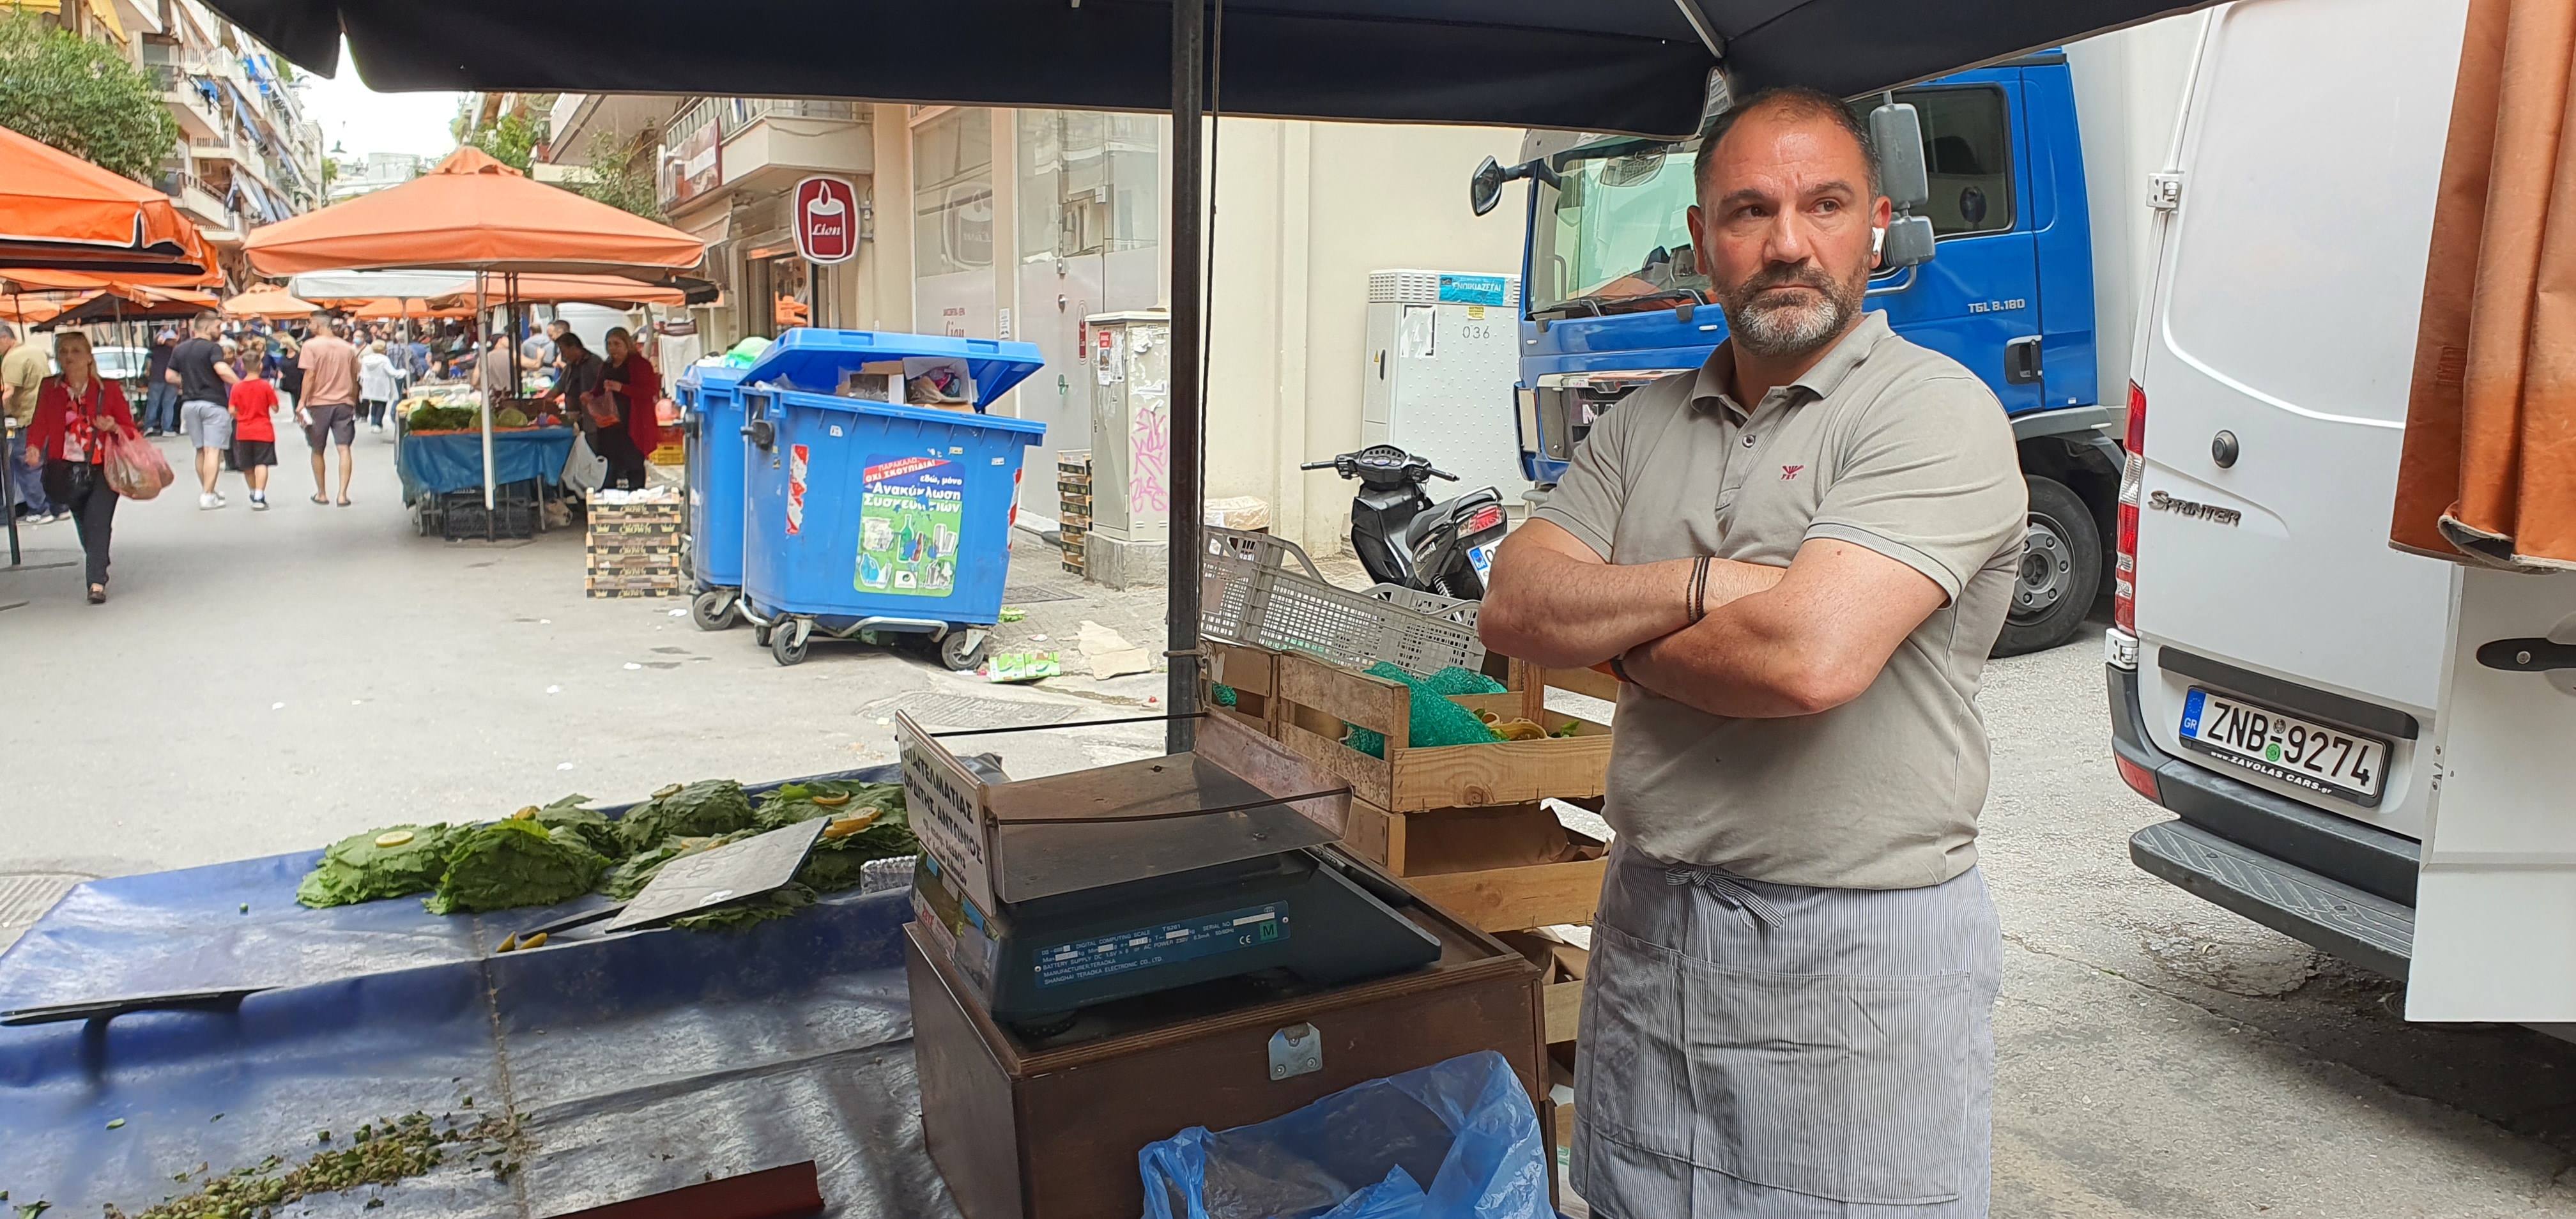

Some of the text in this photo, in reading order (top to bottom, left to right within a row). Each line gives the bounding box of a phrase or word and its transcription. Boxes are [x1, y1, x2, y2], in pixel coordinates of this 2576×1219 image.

[812, 224, 841, 235] Lion
[1968, 299, 2025, 313] TGL 8.180
[1462, 326, 1491, 339] 036
[865, 459, 936, 482] ΟΧΙ ΣΚΟΥΠΙΔΙΑ!
[920, 475, 963, 486] εδώ, μόνο
[2184, 718, 2197, 730] GR
[2211, 751, 2332, 793] www.ZAVOLAS CARS.gr
[937, 805, 983, 864] ΑΝΤΩΝΙΟΣ
[1203, 924, 1220, 932] SERIAL
[1263, 924, 1275, 937] M
[1076, 941, 1096, 949] DIGITAL
[1099, 933, 1131, 945] COMPUTING
[1133, 930, 1150, 938] SCALE
[1043, 960, 1068, 970] BATTERY
[1070, 955, 1092, 965] SUPPLY
[1154, 939, 1174, 948] POWER
[1045, 974, 1074, 985] SHANGHAI
[1077, 969, 1102, 978] TERAOKA
[1105, 961, 1138, 972] ELECTRONIC
